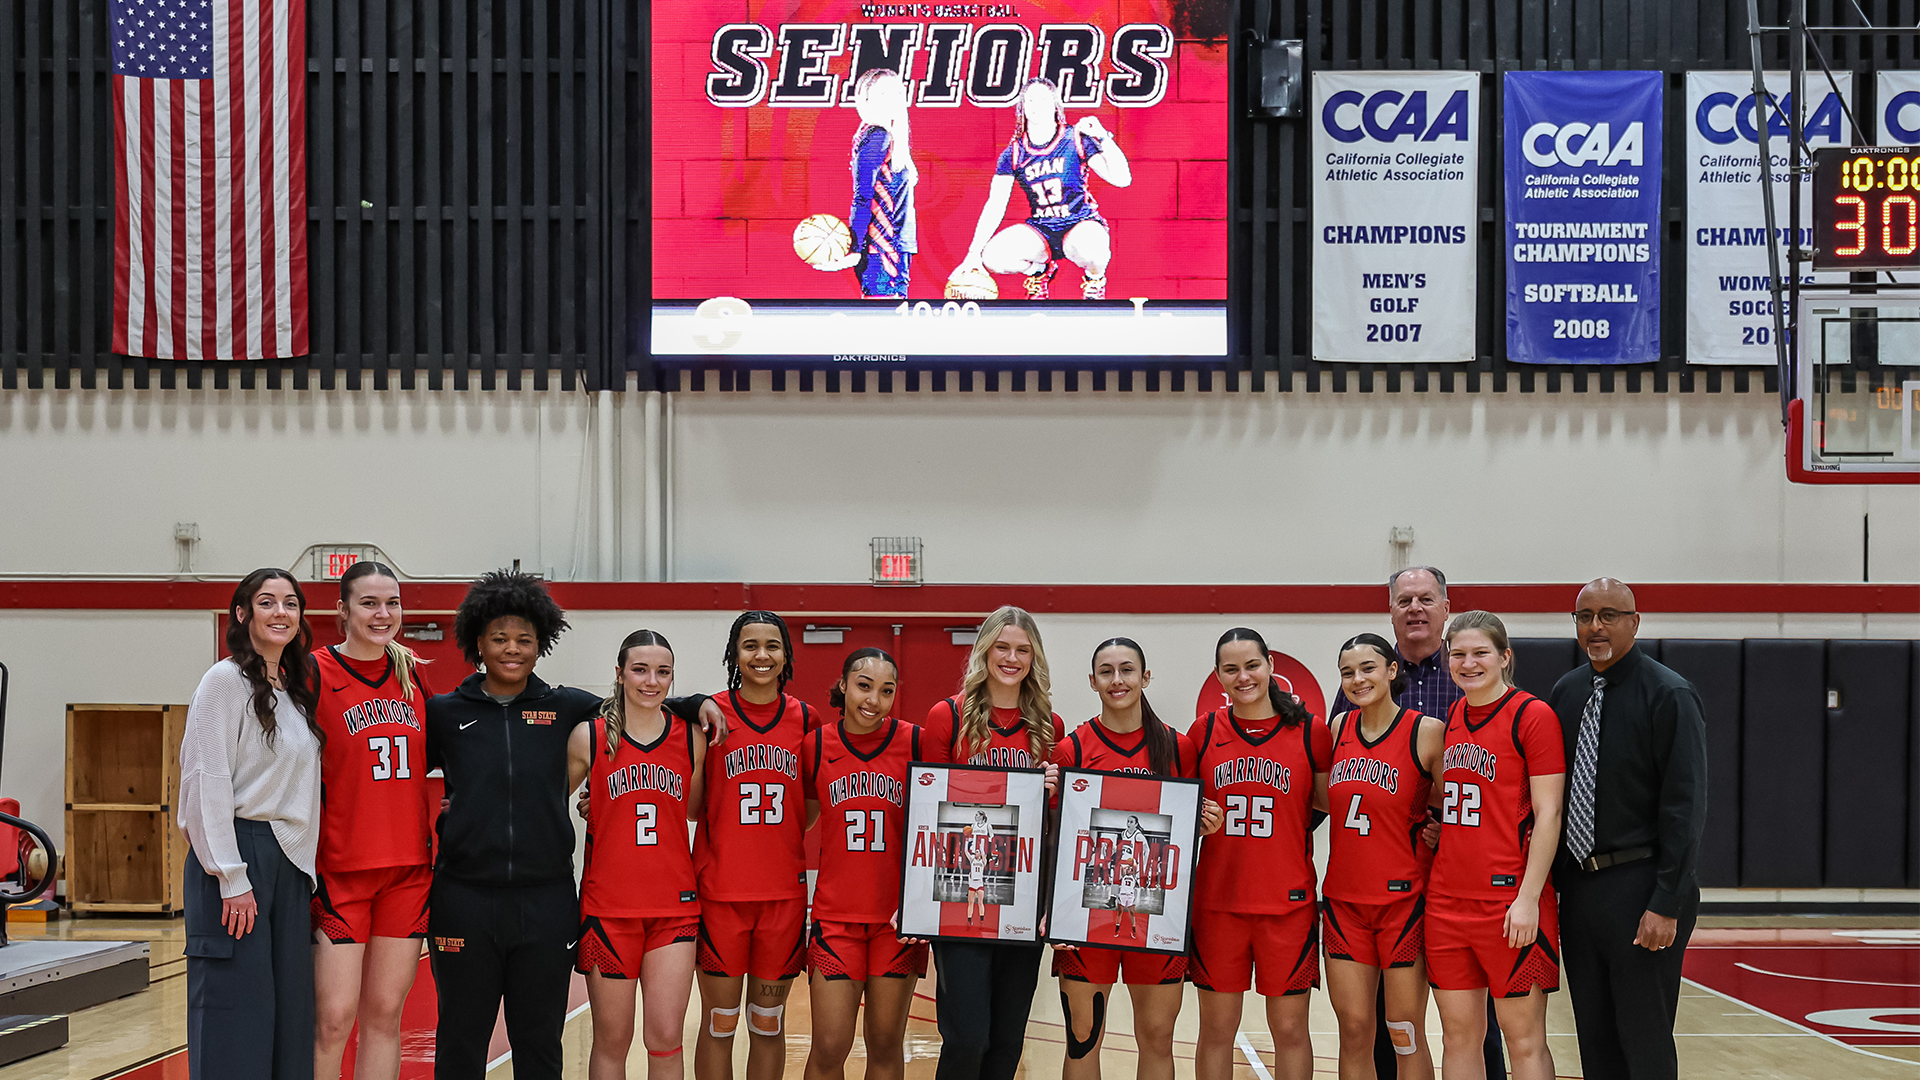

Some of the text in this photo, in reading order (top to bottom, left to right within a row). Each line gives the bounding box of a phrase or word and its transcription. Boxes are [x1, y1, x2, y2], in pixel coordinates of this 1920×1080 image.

[861, 3, 1021, 17] WOMEN'S BASKETBALL
[705, 23, 1175, 108] SENIORS
[1322, 90, 1469, 143] CCAA
[1522, 122, 1644, 168] CCAA
[1850, 146, 1910, 154] DAKTRONICS
[1025, 157, 1065, 181] STAN
[1326, 153, 1464, 168] California Collegiate
[1700, 155, 1762, 167] California
[1326, 169, 1464, 182] Athletic Association
[1525, 174, 1640, 188] California Collegiate
[1700, 171, 1752, 183] Athletic
[1031, 178, 1063, 206] 13
[1525, 187, 1640, 199] Athletic Association
[1323, 226, 1466, 245] CHAMPIONS
[1515, 223, 1649, 239] TOURNAMENT
[1835, 195, 1916, 256] 30
[1513, 244, 1650, 263] CHAMPIONS
[1363, 273, 1426, 290] MEN'S
[1524, 284, 1638, 303] SOFTBALL
[1370, 298, 1419, 313] GOLF
[1366, 324, 1422, 342] 2007
[1553, 319, 1610, 339] 2008
[833, 354, 907, 362] DAKTRONICS
[881, 555, 911, 578] EXIT
[343, 698, 421, 736] WARRIORS
[522, 711, 556, 720] STAN STATE
[368, 736, 411, 781] 31
[724, 744, 798, 780] WARRIORS
[608, 763, 682, 801] WARRIORS
[1214, 756, 1291, 794] WARRIORS
[829, 772, 903, 808] WARRIORS
[739, 783, 785, 825] 23
[1344, 793, 1371, 836] 4
[1442, 781, 1482, 828] 22
[635, 804, 658, 846] 2
[1225, 795, 1274, 838] 25
[844, 810, 886, 852] 21
[1072, 834, 1181, 890] PREMO
